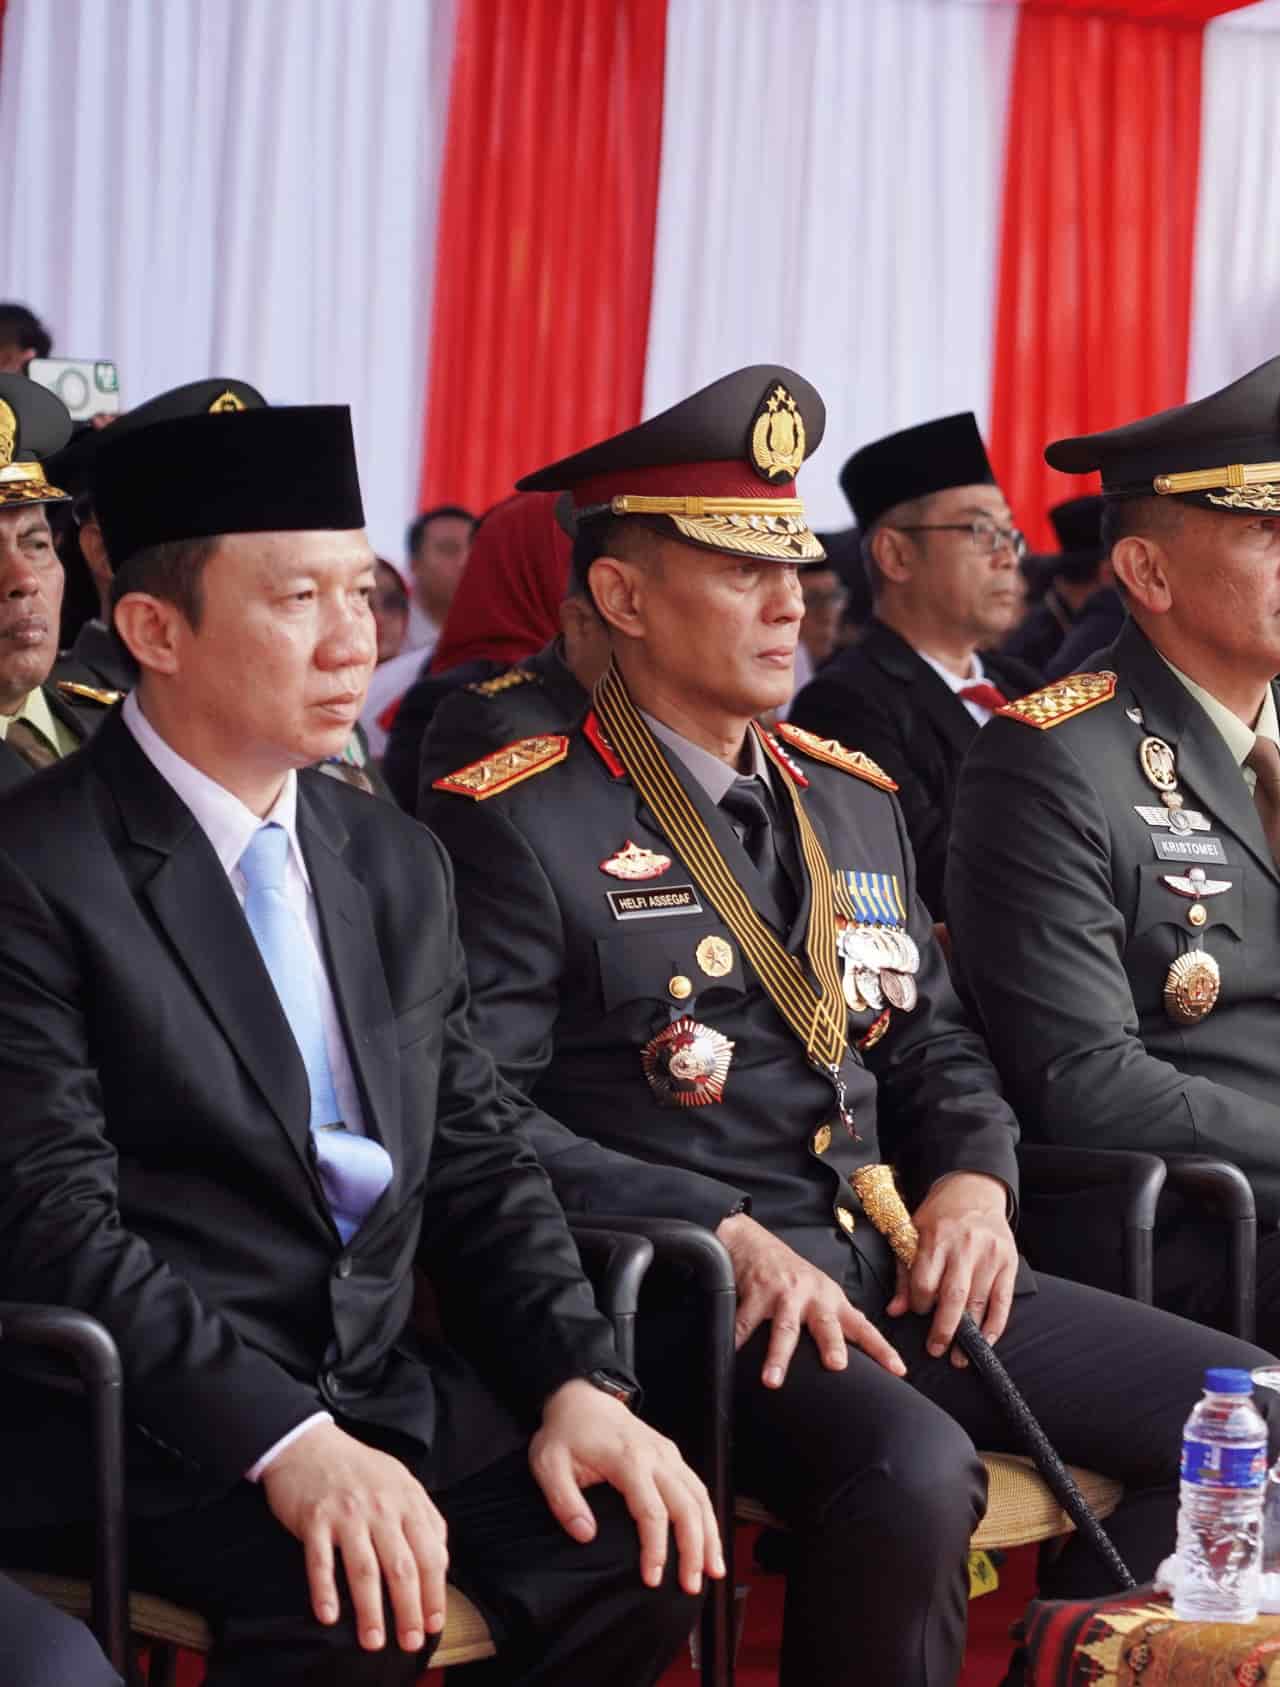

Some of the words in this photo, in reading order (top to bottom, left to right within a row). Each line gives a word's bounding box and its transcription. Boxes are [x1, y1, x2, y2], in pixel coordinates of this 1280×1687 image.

[1161, 840, 1219, 856] KRISTOMEI
[619, 896, 647, 910] HELFI
[649, 893, 690, 908] ASSEGAF
